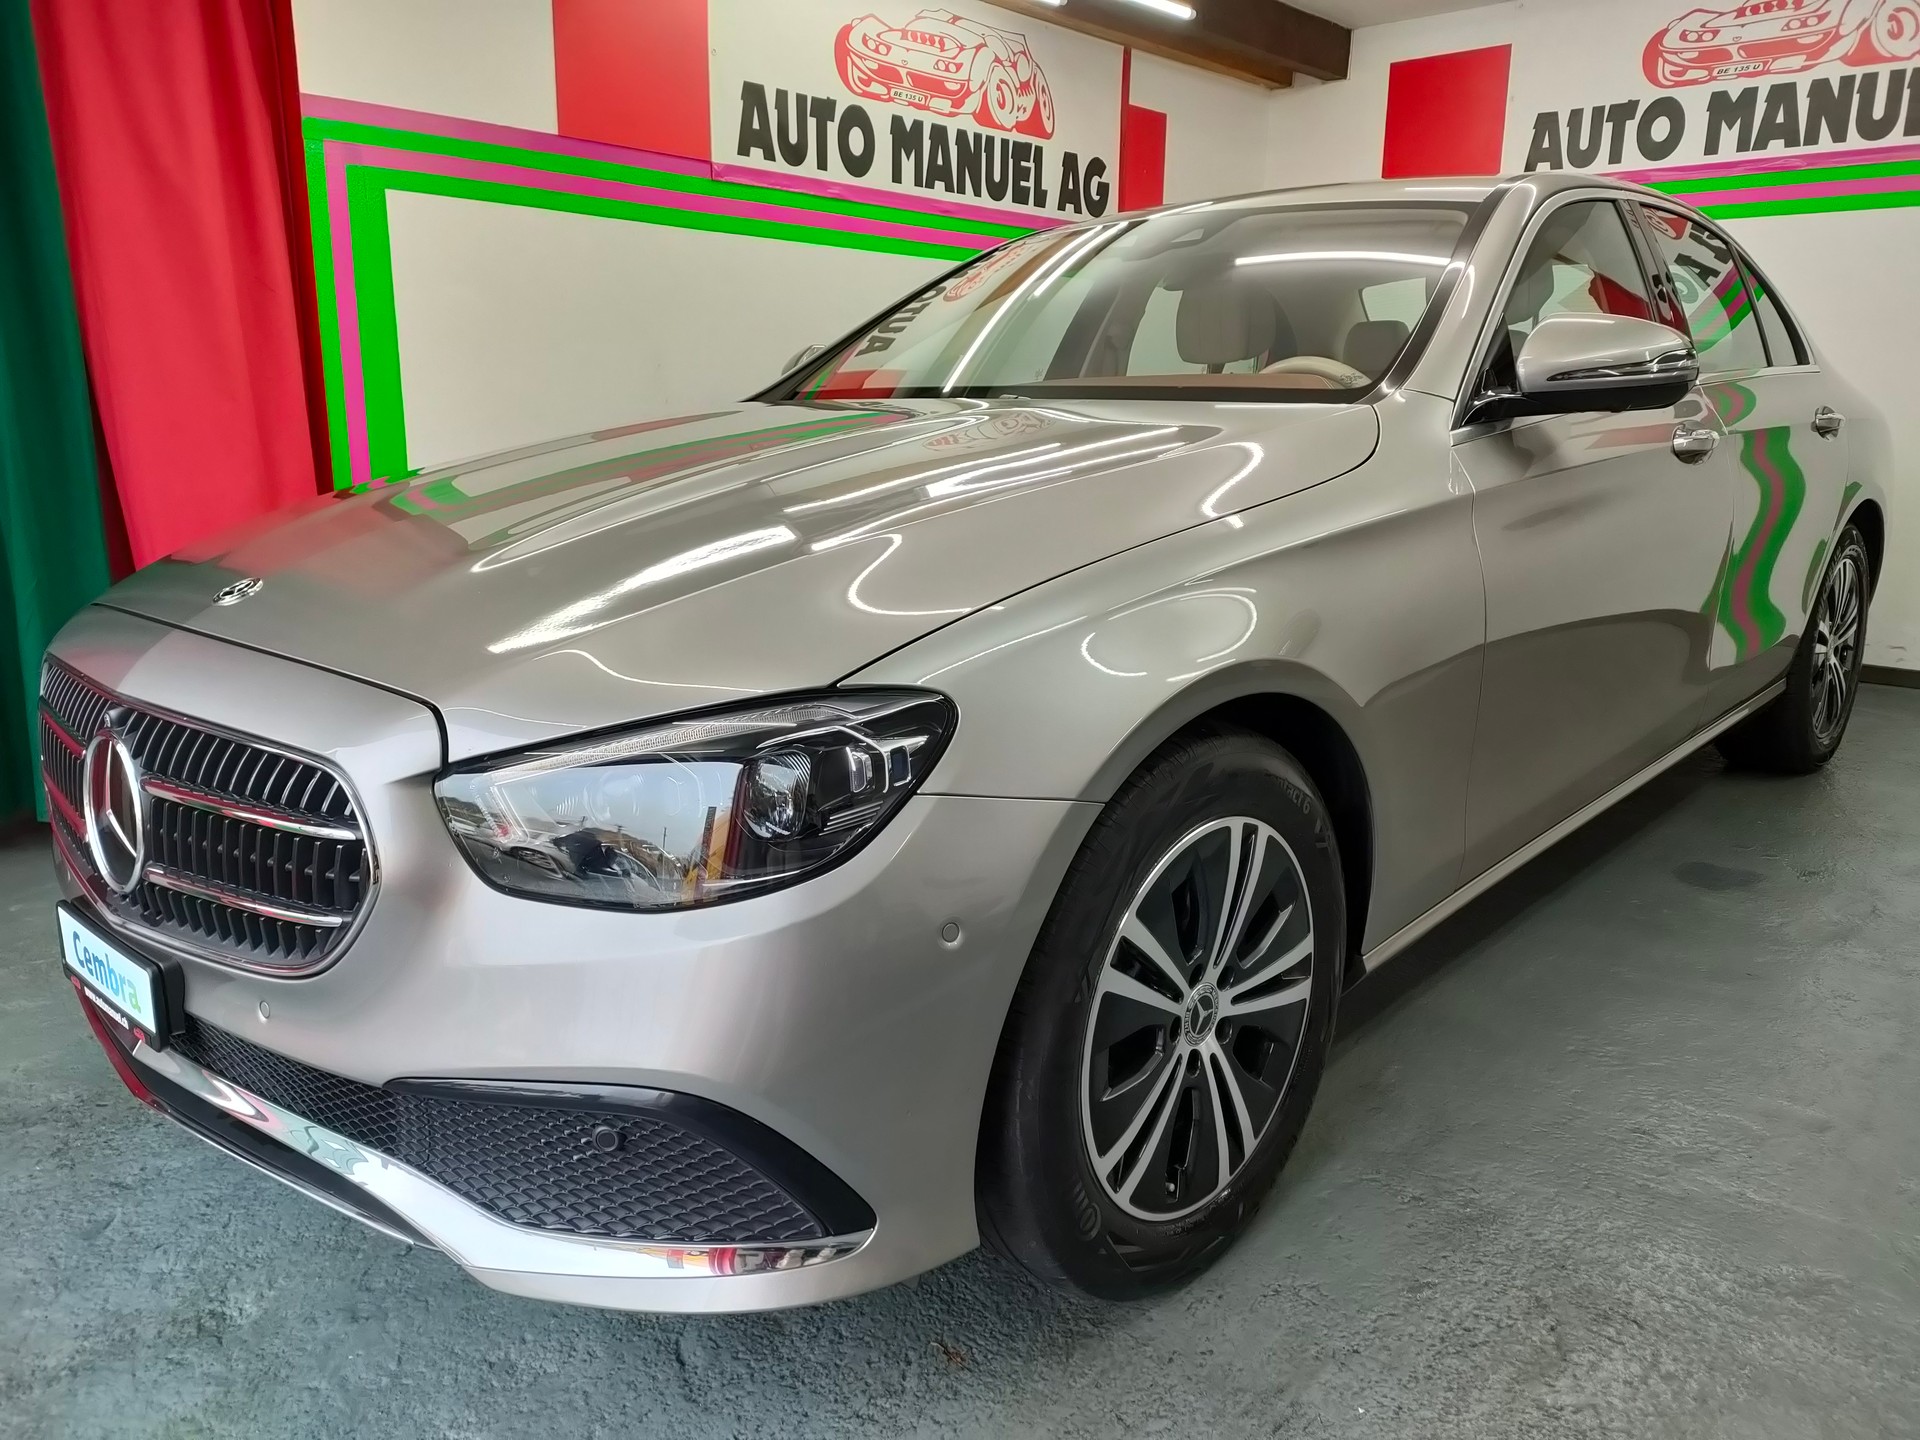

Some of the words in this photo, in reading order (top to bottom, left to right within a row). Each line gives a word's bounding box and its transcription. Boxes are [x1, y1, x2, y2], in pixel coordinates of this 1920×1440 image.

[893, 90, 904, 98] BE
[905, 93, 917, 101] 135
[1716, 67, 1731, 75] BE
[1733, 65, 1751, 73] 135
[736, 80, 876, 179] AUTO
[889, 113, 1048, 209] MANUEL
[1057, 151, 1111, 219] AG
[1524, 96, 1686, 173] AUTO
[72, 930, 142, 1015] Cembra
